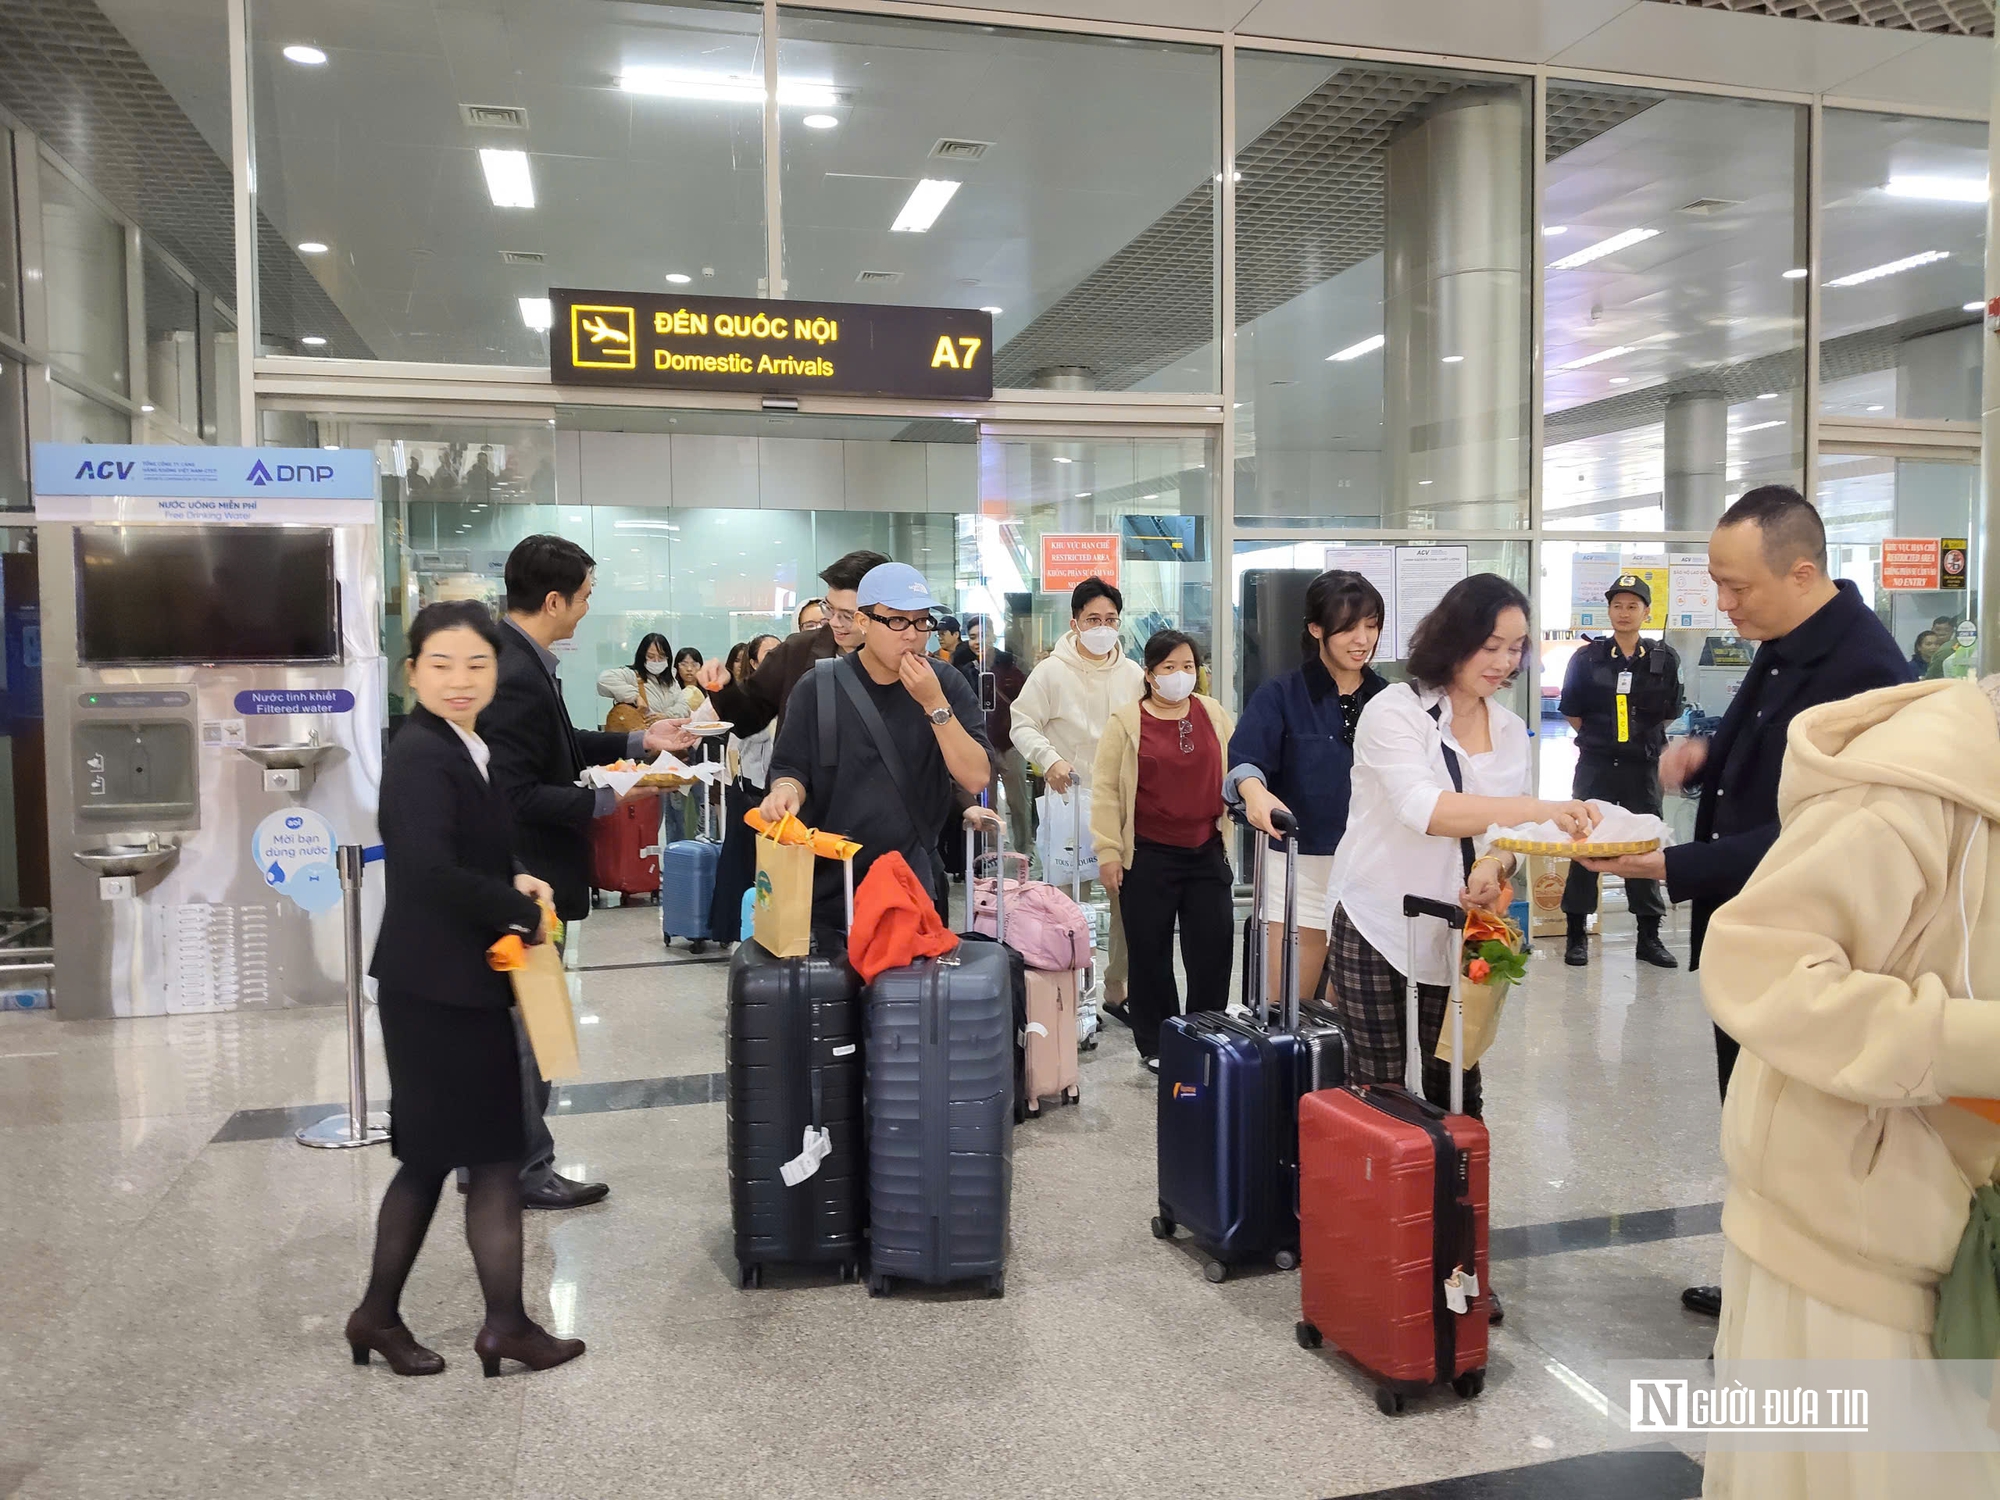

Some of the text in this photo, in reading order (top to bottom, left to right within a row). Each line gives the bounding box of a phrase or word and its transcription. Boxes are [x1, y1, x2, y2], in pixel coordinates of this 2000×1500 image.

[794, 316, 838, 345] NỘI
[930, 335, 982, 369] A7
[654, 349, 834, 376] Domestic Arrivals
[75, 461, 135, 480] ACV
[277, 465, 334, 482] DNP
[165, 511, 251, 521] Free Drinking Water
[252, 693, 284, 702] Nước
[257, 704, 333, 713] Filtered water
[273, 835, 320, 845] Mời bạn
